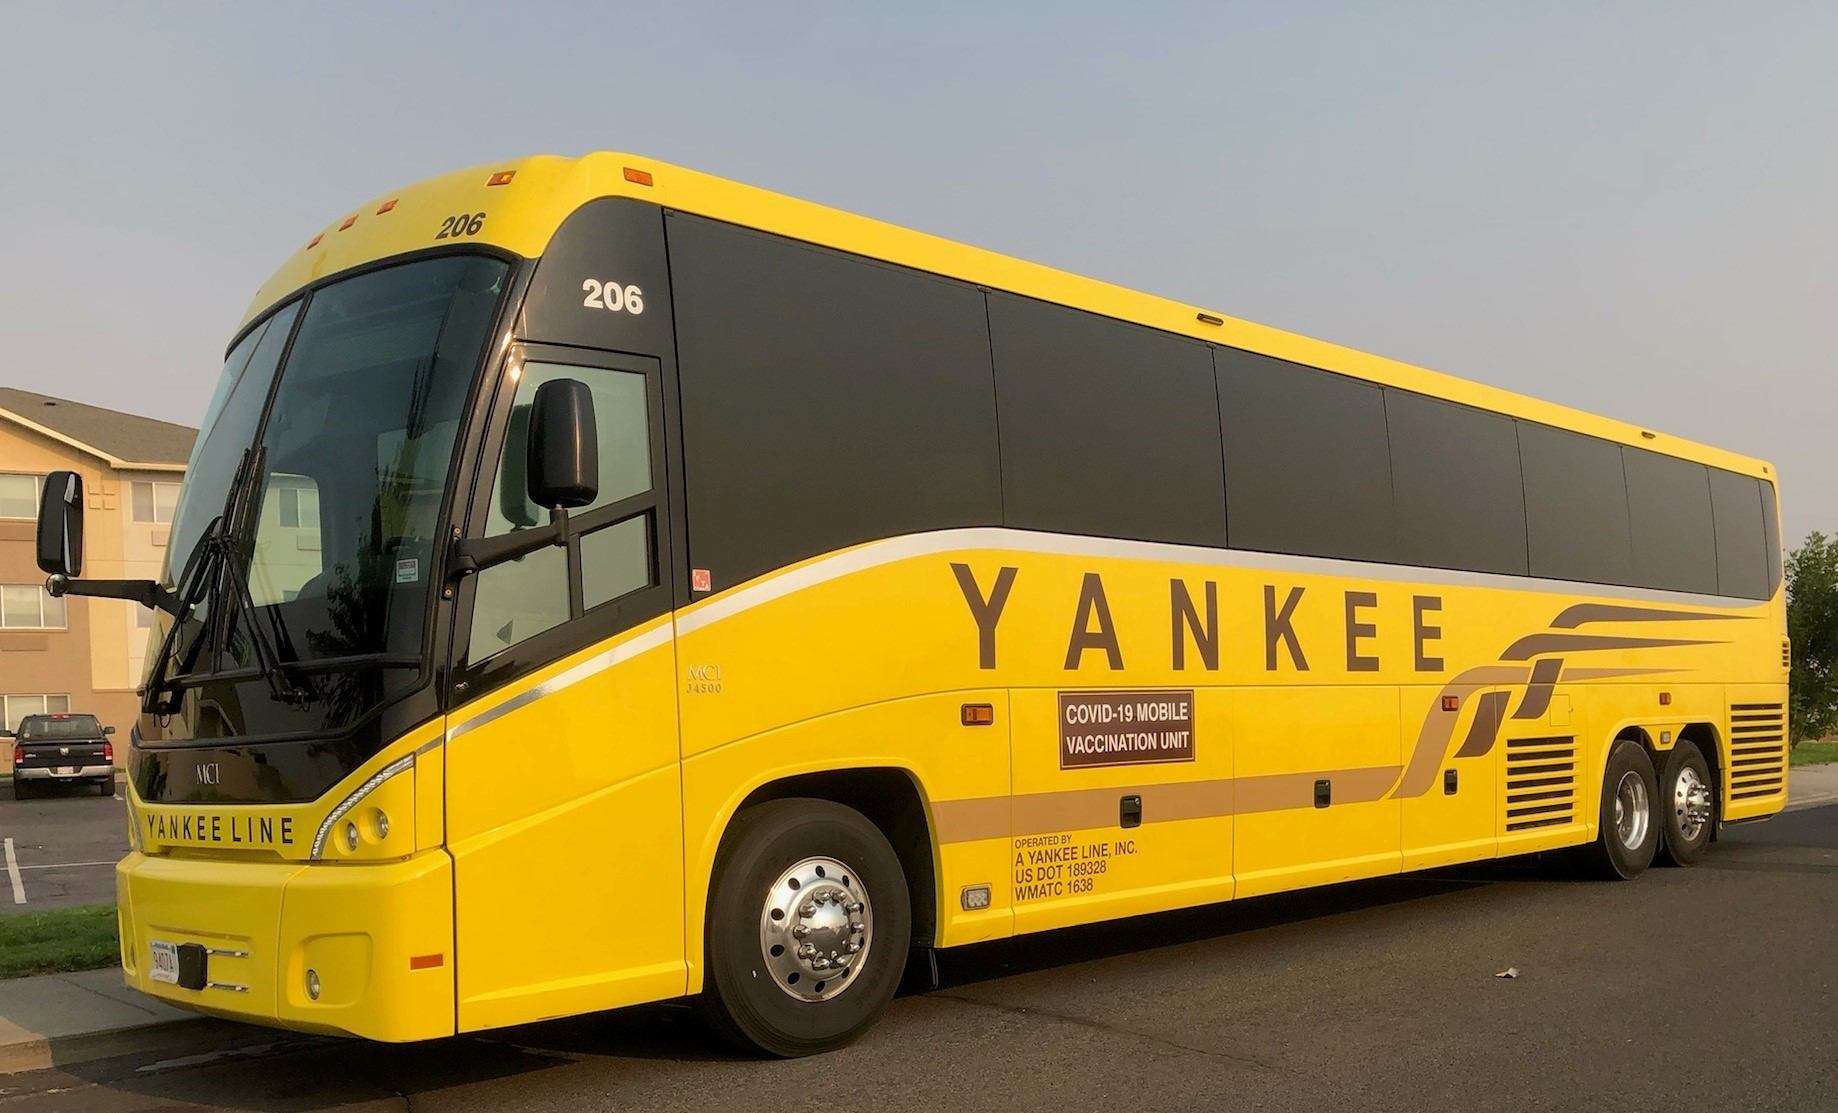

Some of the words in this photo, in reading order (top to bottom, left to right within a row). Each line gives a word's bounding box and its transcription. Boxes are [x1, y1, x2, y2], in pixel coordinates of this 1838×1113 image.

[434, 212, 486, 240] 206
[582, 278, 644, 315] 206
[950, 562, 1445, 672] YANKEE
[687, 664, 722, 681] MCI
[686, 683, 722, 694] J4500
[1066, 703, 1134, 725] COVID-19
[1136, 702, 1189, 722] MOBILE
[1066, 732, 1157, 755] VACCINATION
[1160, 731, 1190, 750] UNIT
[196, 763, 220, 785] MCI
[147, 814, 221, 842] YANKEE
[231, 816, 294, 844] LINE
[1014, 835, 1059, 849] OPERATED
[1061, 834, 1072, 844] BY
[1015, 852, 1025, 867] A
[1028, 846, 1078, 865] YANKEE
[1081, 843, 1112, 859] LINE,
[1115, 840, 1138, 856] INC.
[1015, 868, 1033, 884] US
[1037, 865, 1064, 881] DOT
[1067, 860, 1107, 877] 189328
[1015, 881, 1063, 901] WMATC
[1067, 877, 1094, 894] 1638
